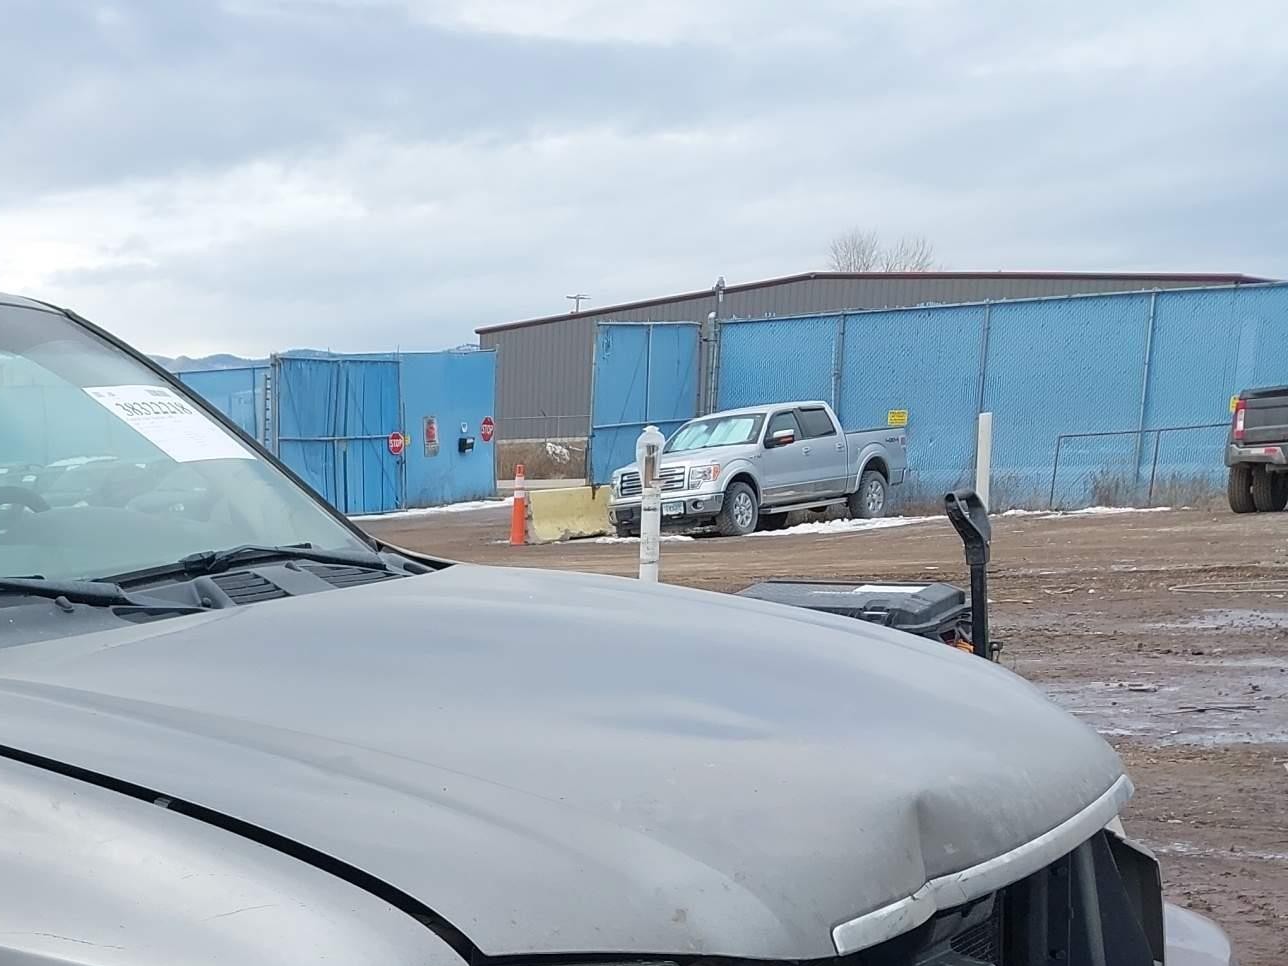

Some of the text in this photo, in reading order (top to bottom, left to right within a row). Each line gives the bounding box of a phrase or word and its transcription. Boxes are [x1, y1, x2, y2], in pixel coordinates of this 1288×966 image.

[114, 401, 193, 416] 38322218
[481, 424, 494, 434] STOP
[389, 438, 404, 448] STOP
